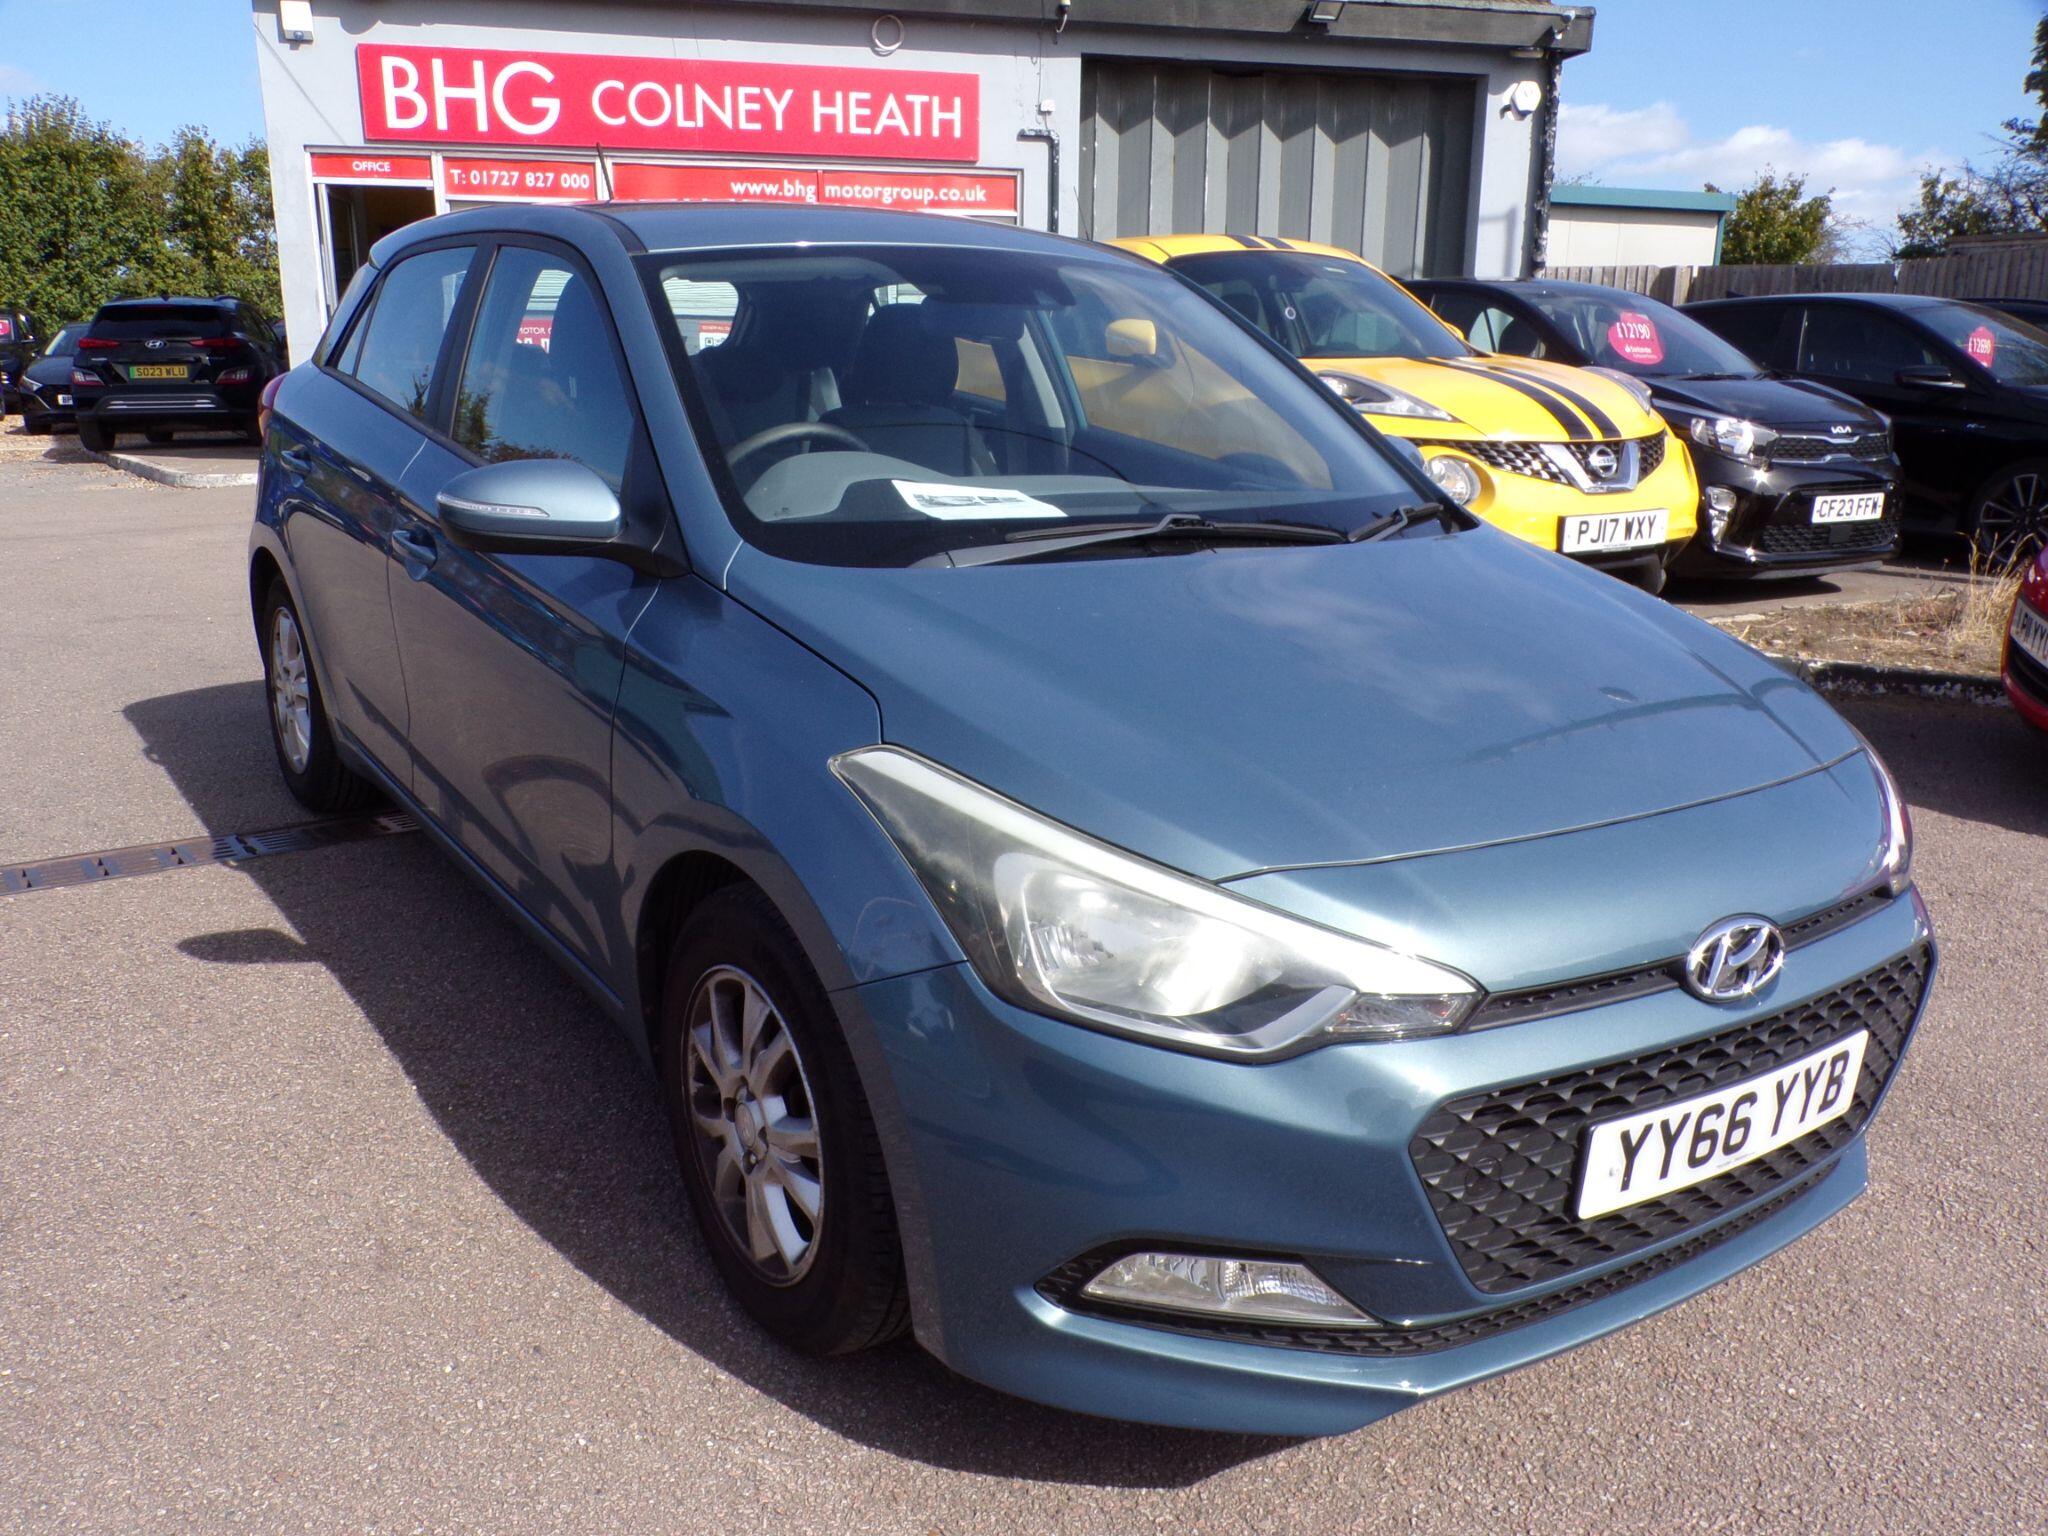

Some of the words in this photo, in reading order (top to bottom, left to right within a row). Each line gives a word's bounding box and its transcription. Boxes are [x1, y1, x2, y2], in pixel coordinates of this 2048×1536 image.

[381, 56, 561, 136] BHG
[591, 79, 794, 131] COLNEY
[812, 89, 962, 138] HEATH
[352, 160, 391, 172] OFFICE
[450, 169, 466, 184] T:
[470, 169, 519, 186] 01727
[525, 171, 555, 188] 827
[560, 172, 591, 189] 000
[730, 179, 816, 201] www.bhg
[824, 184, 987, 205] motorgroup.co.uk
[1616, 321, 1651, 340] £12190
[136, 366, 163, 377] SO23
[165, 366, 186, 377] WLU
[1819, 498, 1855, 518] CF23
[1855, 496, 1880, 516] FFW
[1577, 518, 1619, 544] PJ17
[1624, 515, 1657, 541] WXY
[1618, 1091, 1759, 1193] YY66
[1770, 1049, 1851, 1139] YYB
